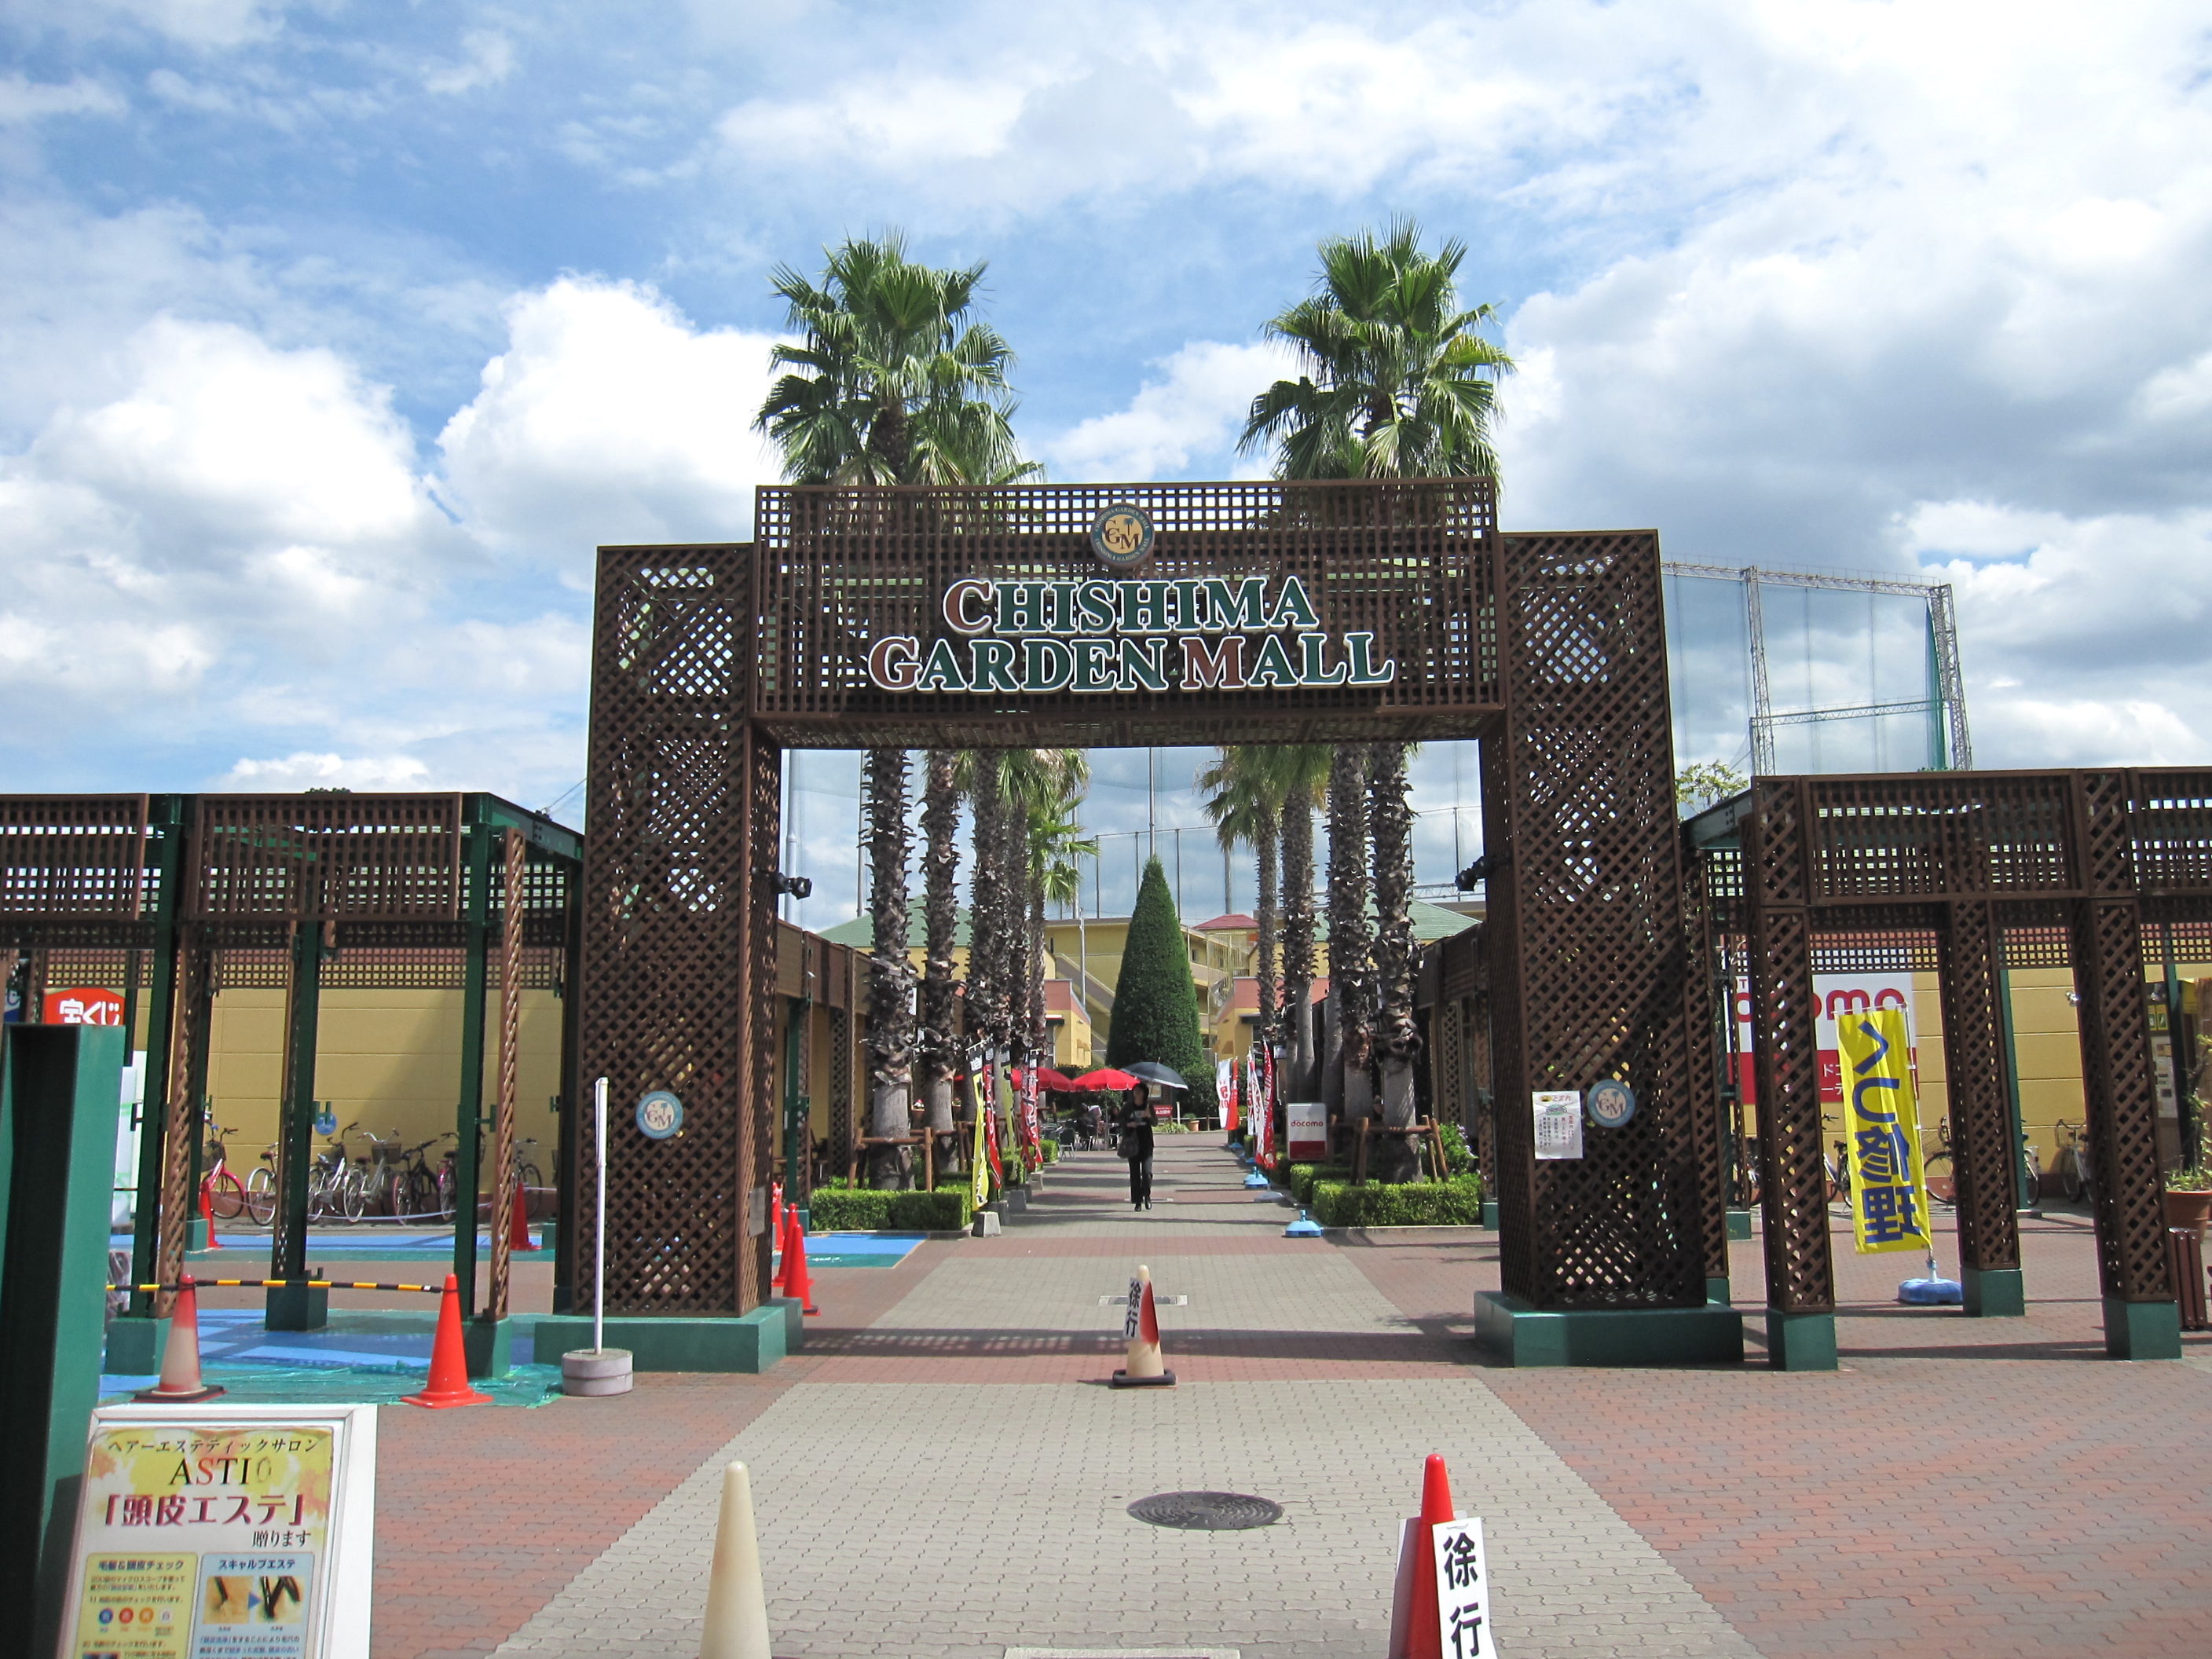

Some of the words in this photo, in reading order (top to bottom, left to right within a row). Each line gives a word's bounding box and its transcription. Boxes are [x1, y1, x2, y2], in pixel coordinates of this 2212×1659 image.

[943, 575, 1320, 634] CHISHIMA
[867, 635, 1170, 693] GARDEN
[1179, 631, 1395, 690] MALL
[59, 998, 121, 1025] 宝くじ
[1126, 1281, 1141, 1337] 徐行
[108, 1438, 319, 1454] ヘアーエステティックサロン
[105, 1494, 305, 1526] 「頭皮エステ」
[252, 1530, 312, 1548] 贈ります
[1443, 1533, 1482, 1659] 徐行
